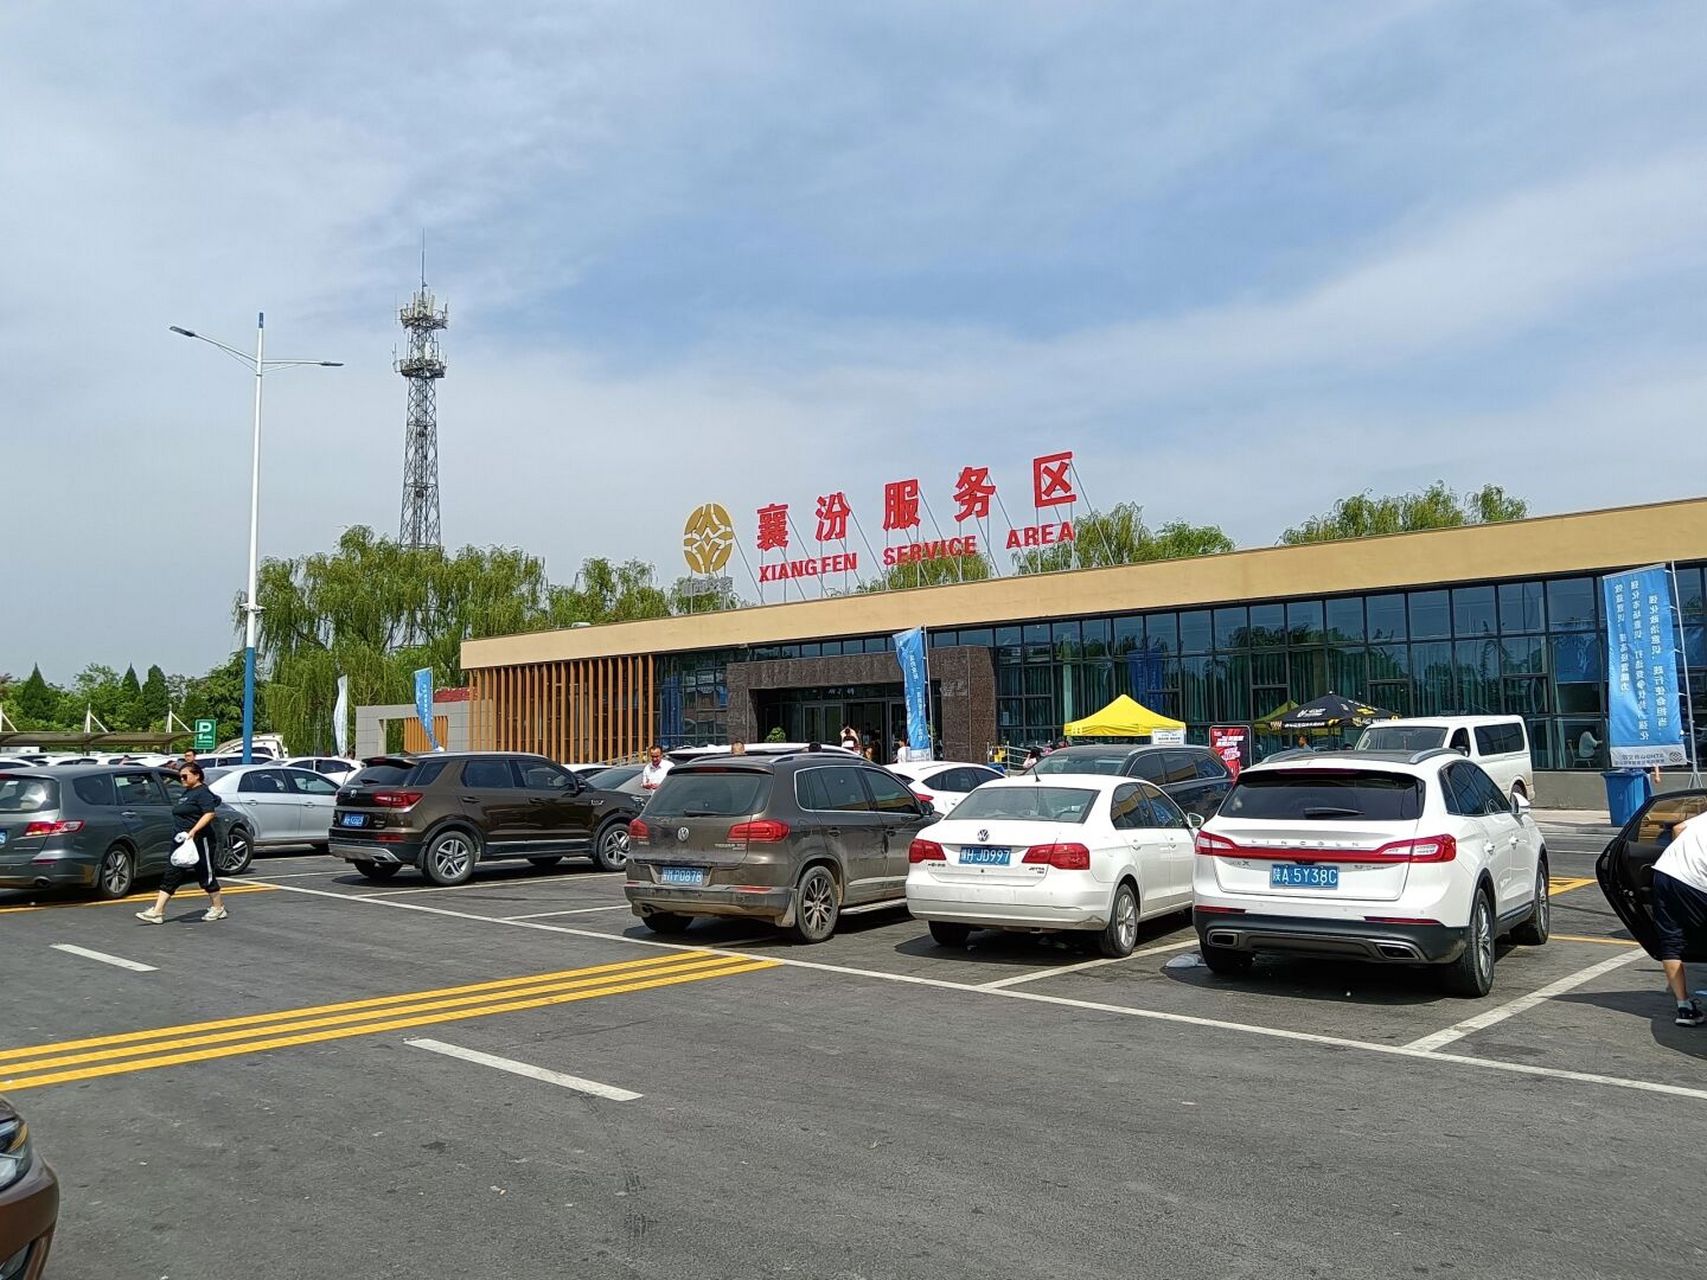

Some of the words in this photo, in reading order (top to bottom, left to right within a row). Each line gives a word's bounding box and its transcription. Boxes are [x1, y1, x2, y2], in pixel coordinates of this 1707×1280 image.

[757, 451, 1077, 551] 襄汾服务区
[759, 554, 857, 583] XIANGFEN
[883, 535, 977, 566] SERVICE
[1006, 521, 1076, 549] AREA
